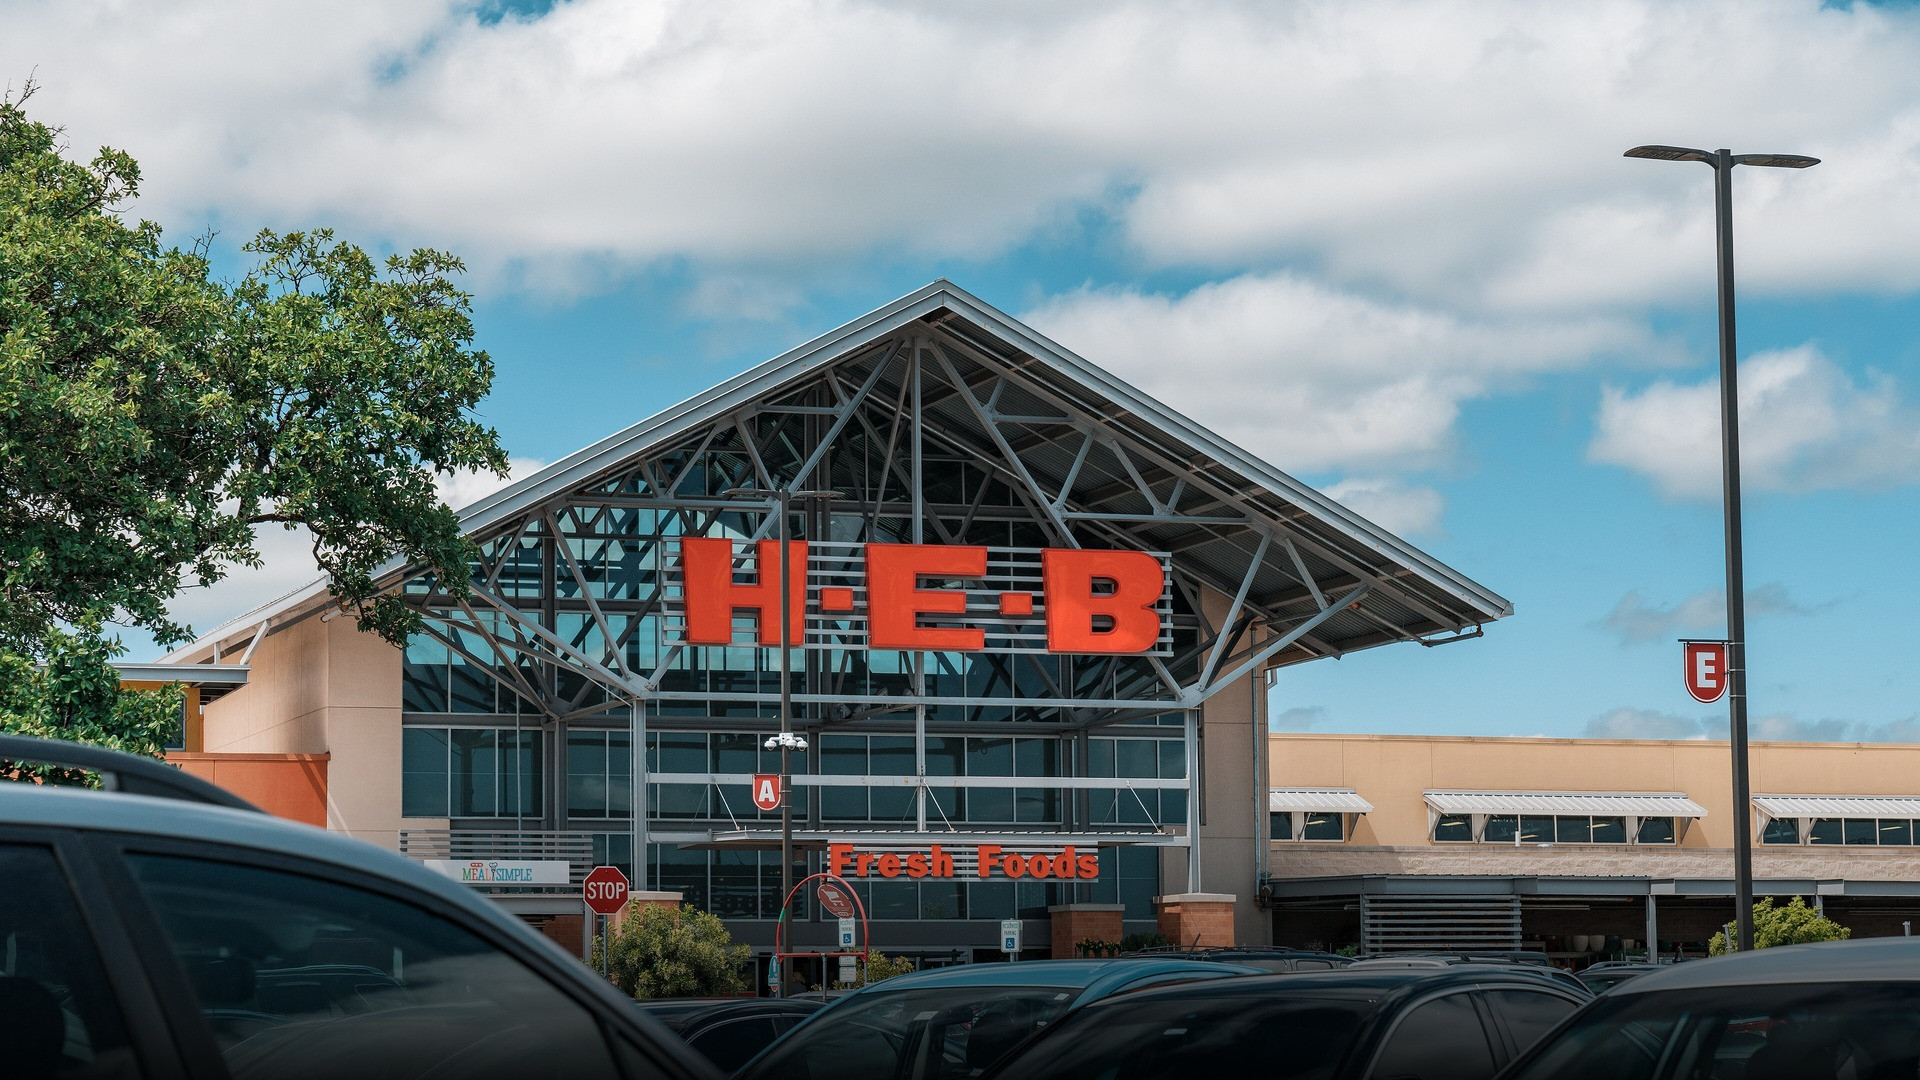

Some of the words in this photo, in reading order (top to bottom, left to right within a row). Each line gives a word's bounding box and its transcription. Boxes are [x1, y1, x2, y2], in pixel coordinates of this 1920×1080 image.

[1696, 652, 1717, 688] E
[758, 780, 776, 802] A
[829, 843, 954, 878] Fresh
[978, 844, 1099, 879] Foods
[462, 868, 491, 881] MEAL
[496, 868, 533, 881] SIMPLE
[587, 881, 626, 900] STOP
